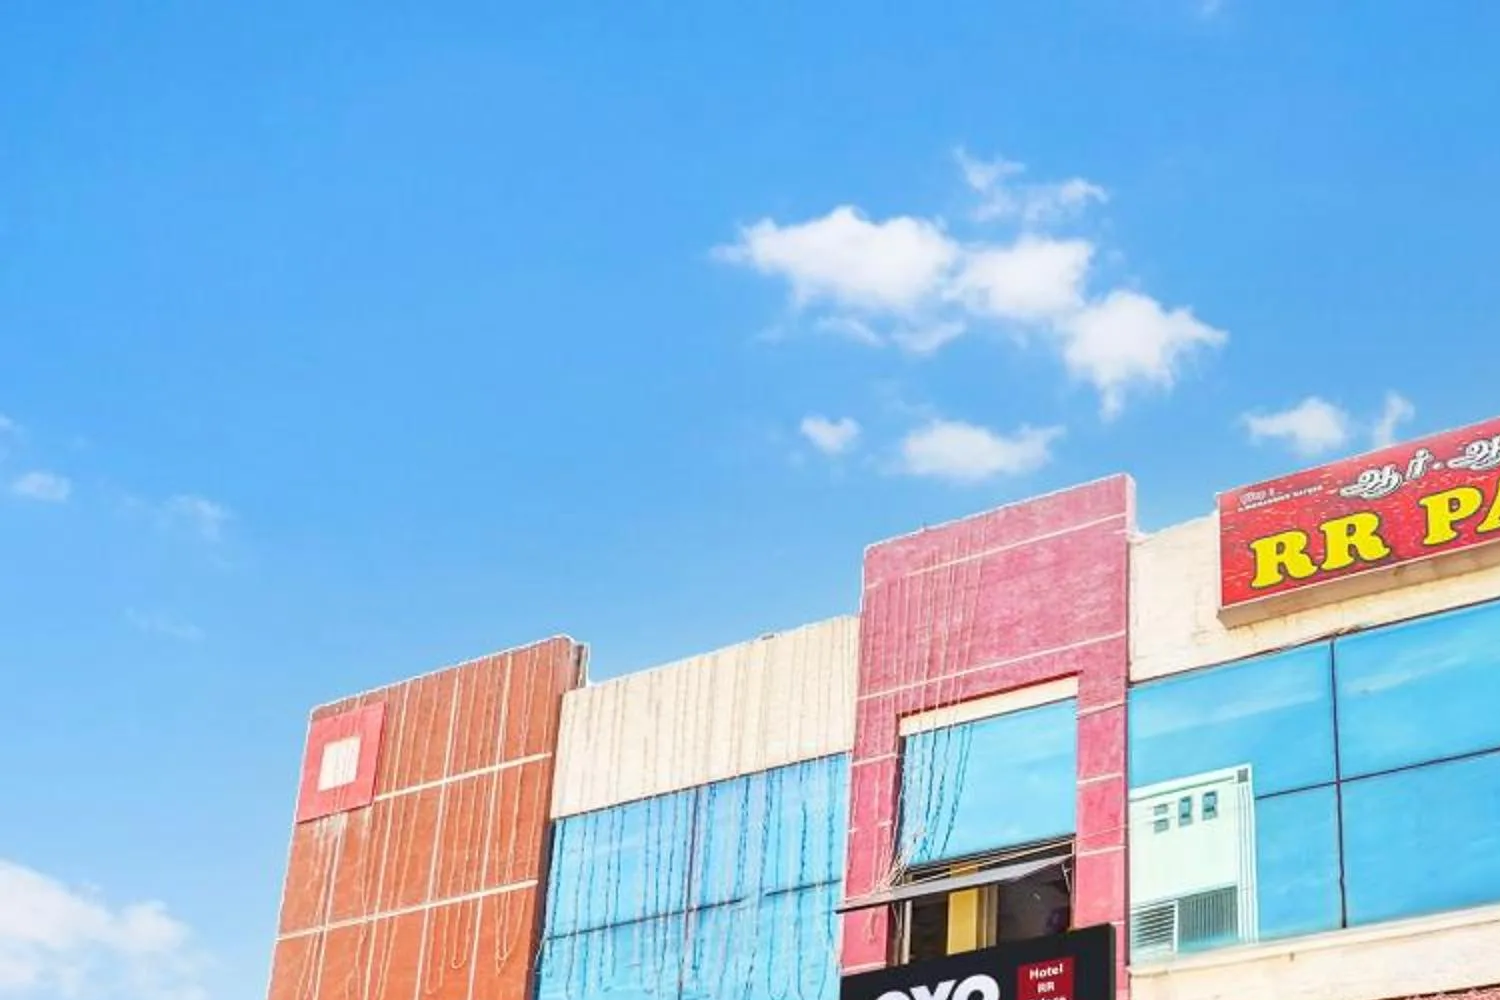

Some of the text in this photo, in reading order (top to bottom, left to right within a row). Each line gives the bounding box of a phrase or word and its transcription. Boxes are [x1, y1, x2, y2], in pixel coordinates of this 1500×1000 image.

[1249, 511, 1391, 589] RR
[1029, 963, 1064, 980] Hotel
[1037, 982, 1055, 994] RR
